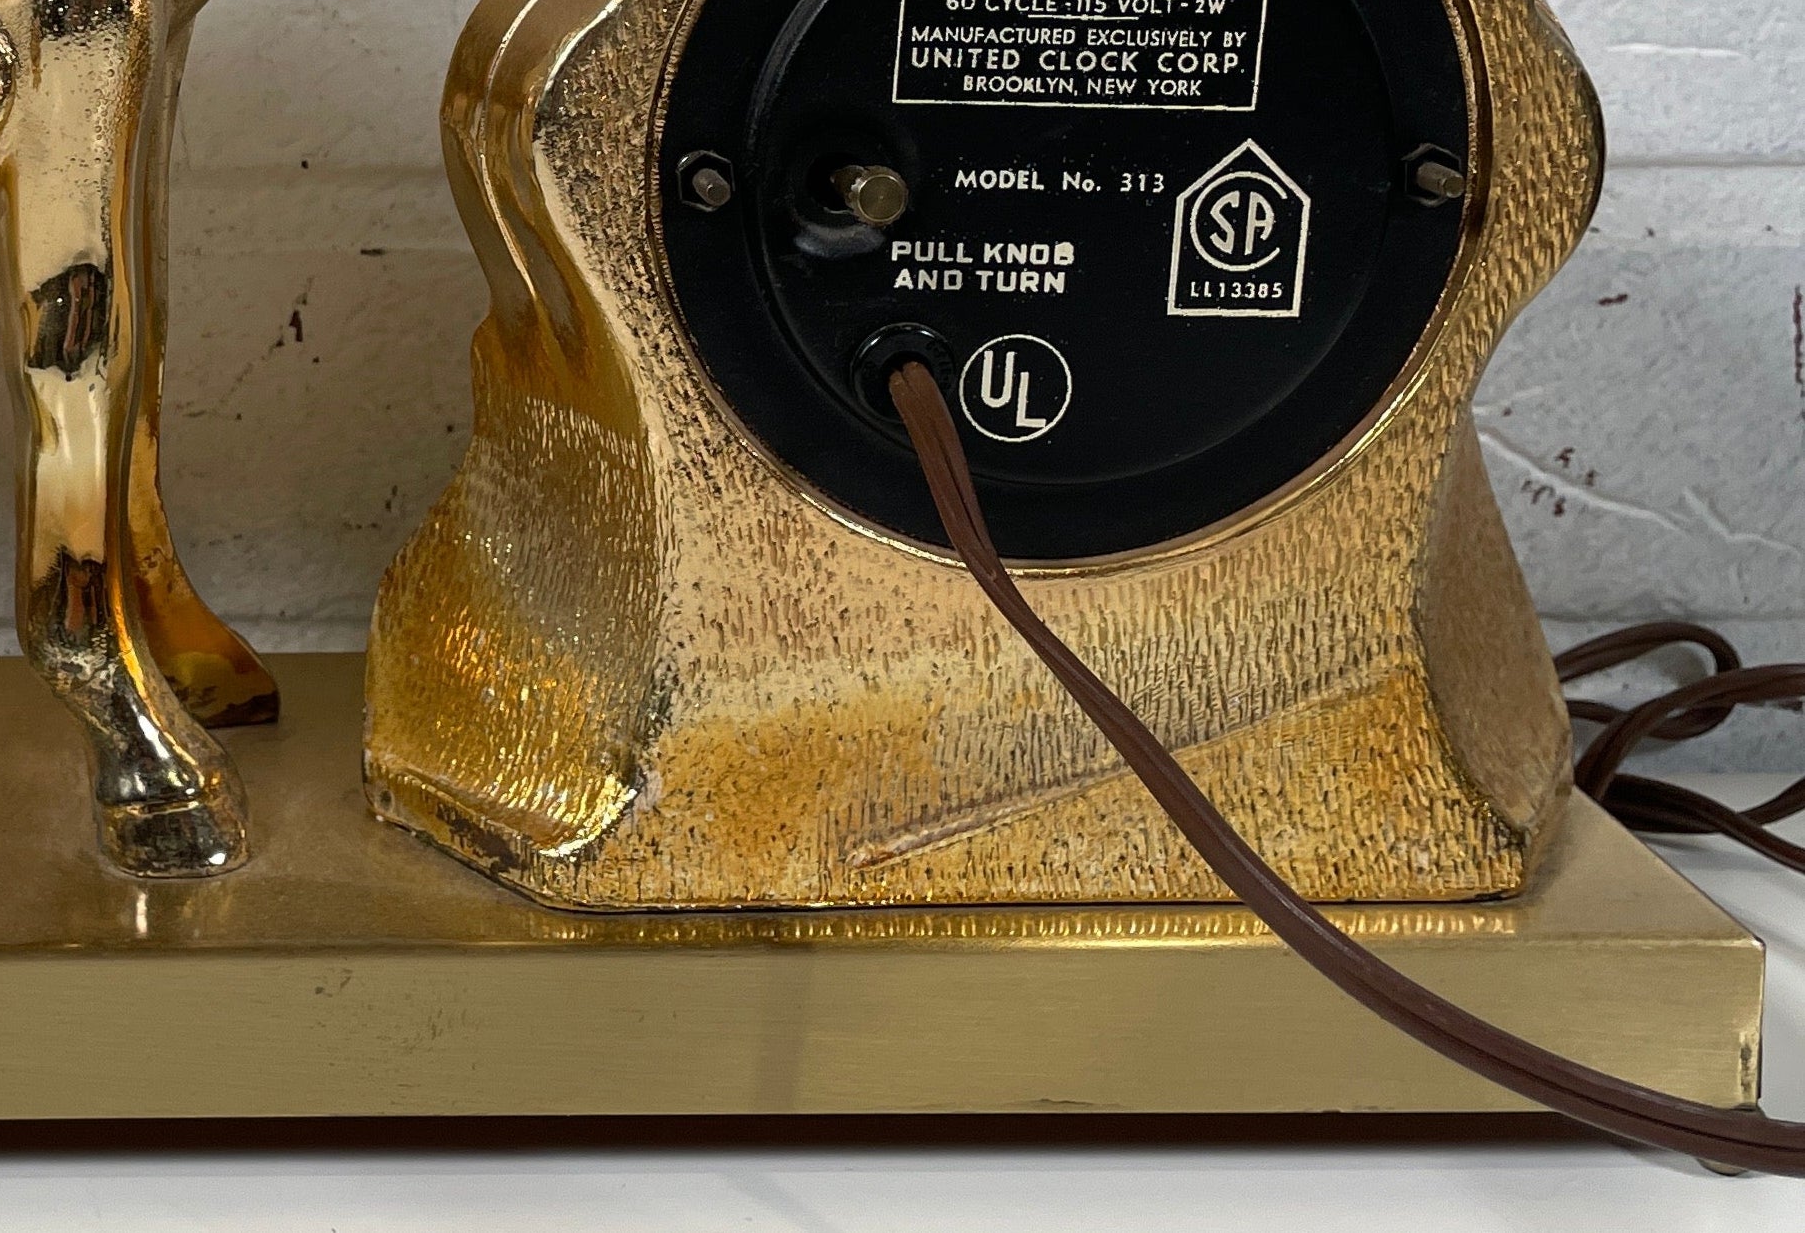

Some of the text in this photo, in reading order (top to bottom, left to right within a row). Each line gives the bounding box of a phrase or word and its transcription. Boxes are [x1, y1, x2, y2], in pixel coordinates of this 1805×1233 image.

[912, 26, 1246, 47] MANUFACTURED EXCLUSIVELY BY
[912, 47, 1244, 73] UNITED CLOCK CORP.
[964, 75, 1202, 96] BROOKLYN, NEW YORK
[955, 168, 1164, 192] MODEL No. 313
[892, 241, 1074, 265] PULL KNOB
[894, 268, 1065, 293] AND TURN
[1191, 281, 1282, 298] LL13385
[981, 350, 1047, 428] UL
